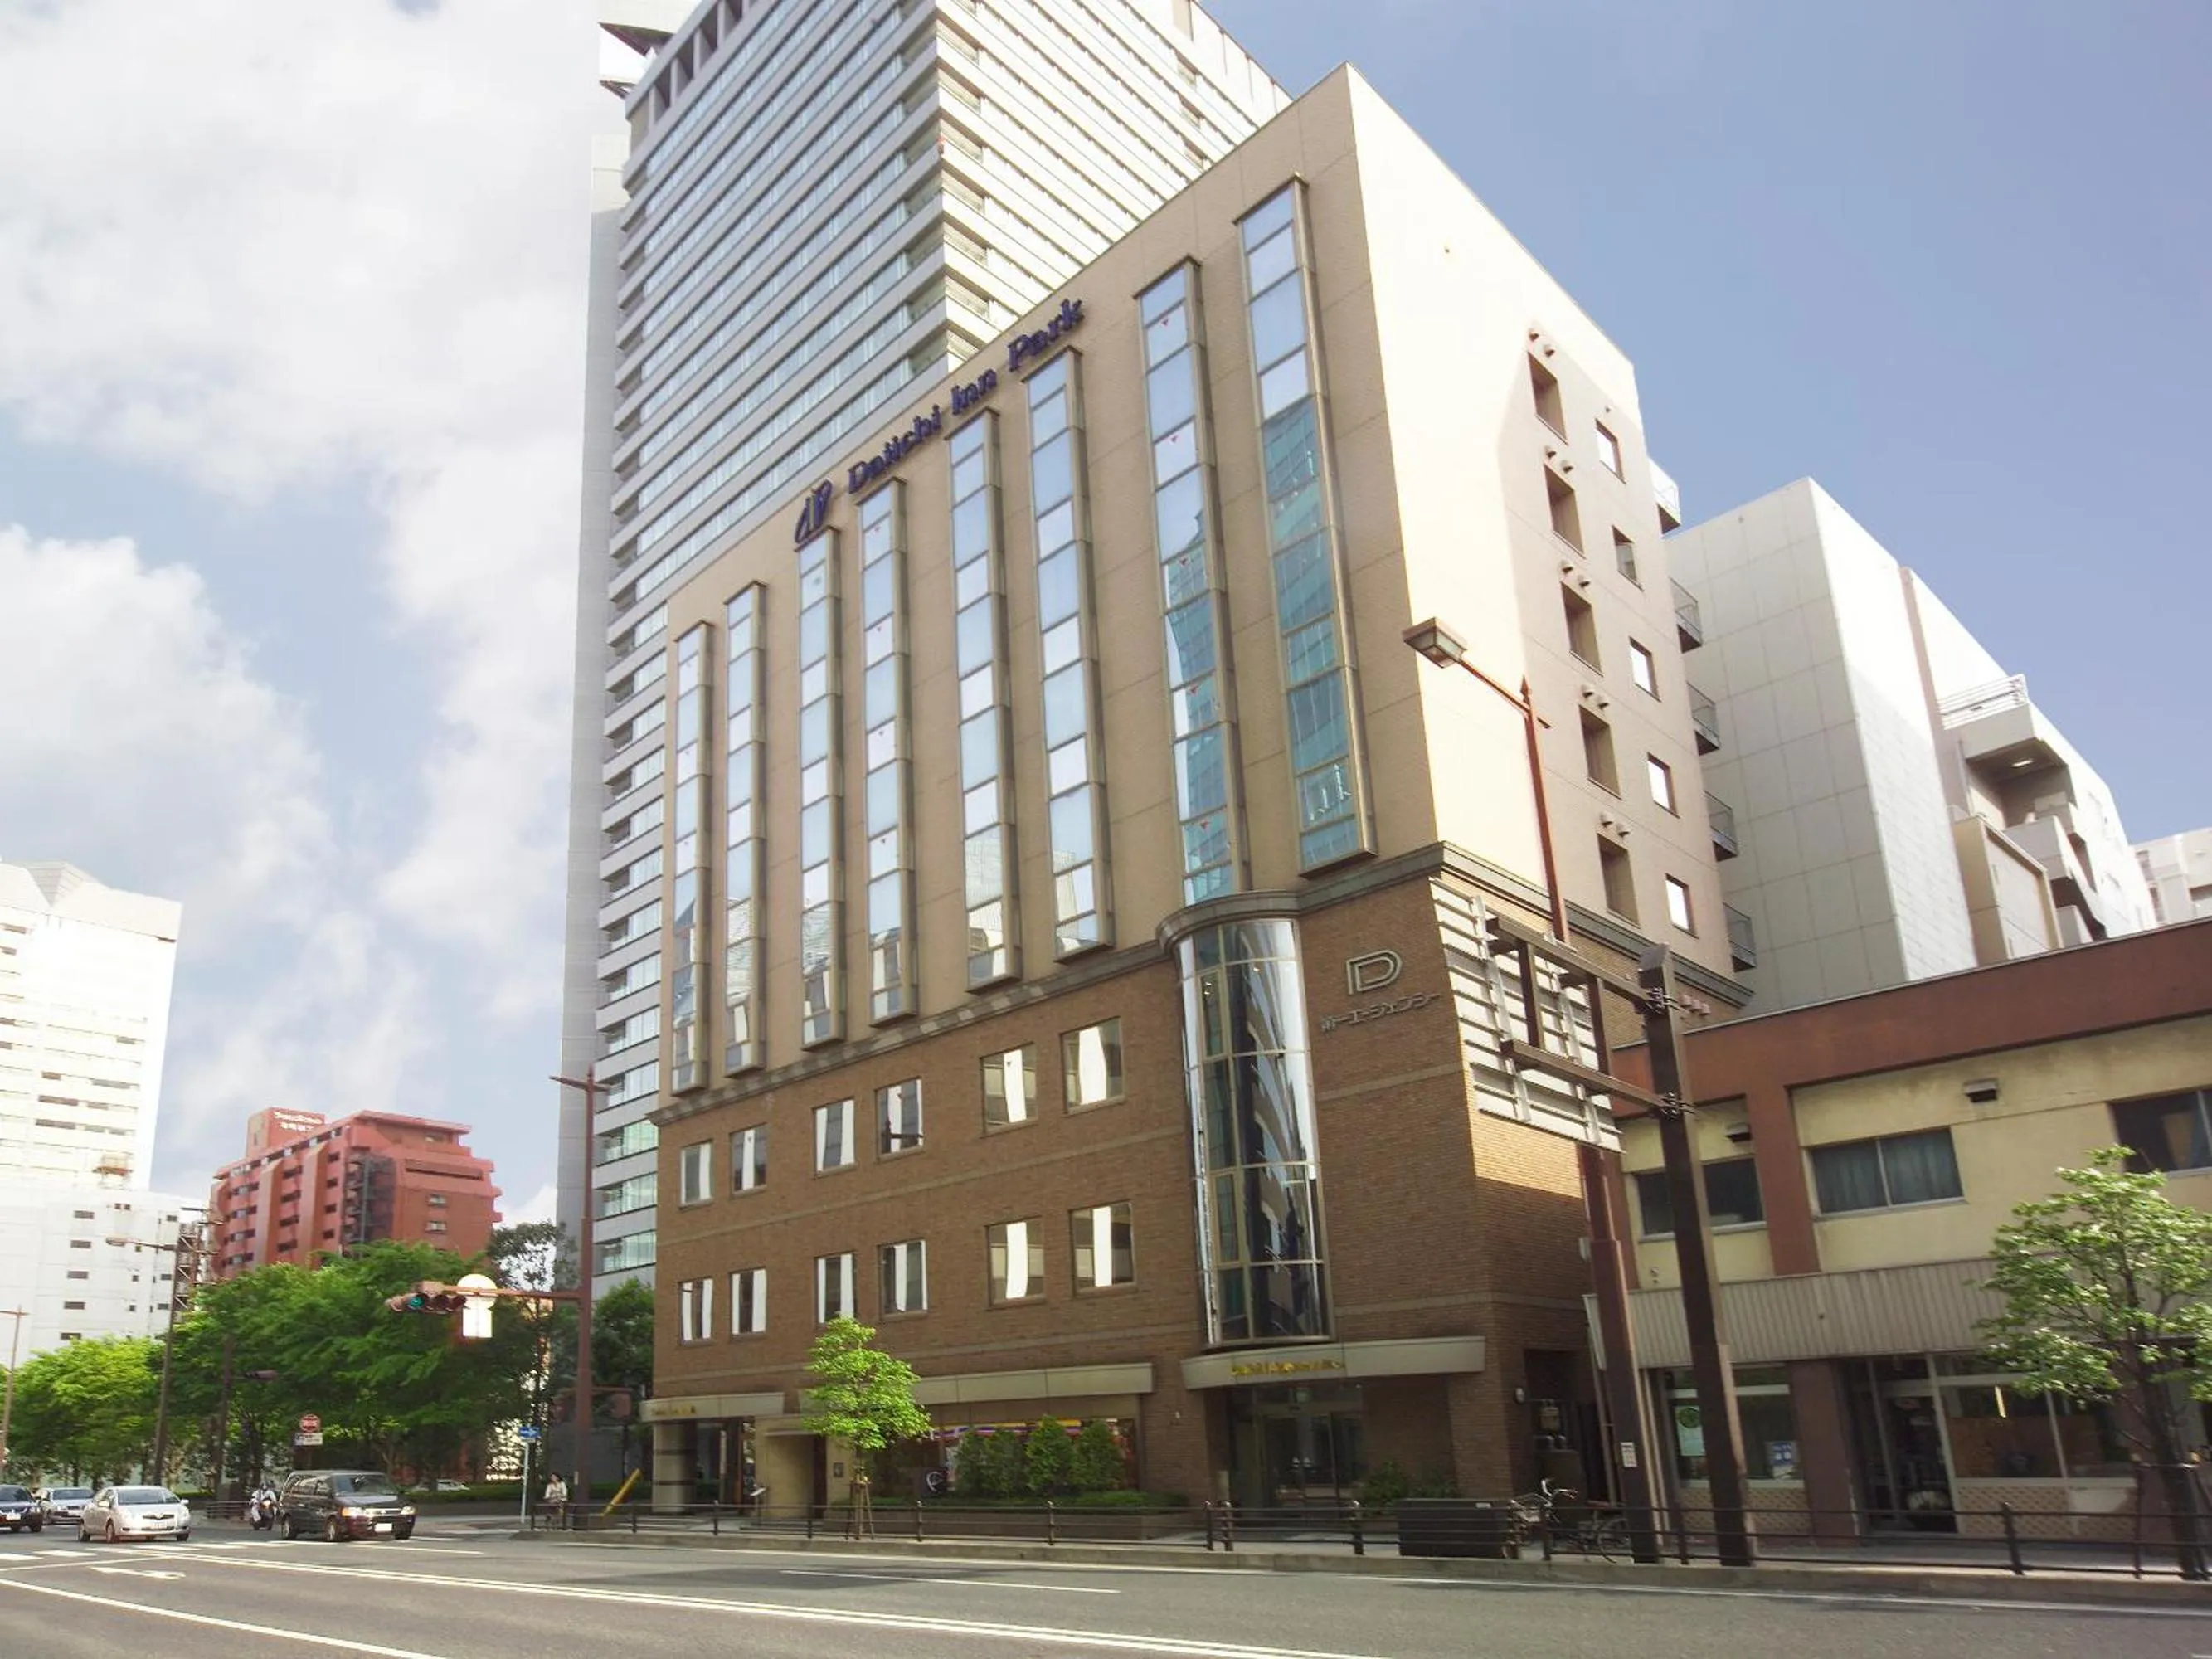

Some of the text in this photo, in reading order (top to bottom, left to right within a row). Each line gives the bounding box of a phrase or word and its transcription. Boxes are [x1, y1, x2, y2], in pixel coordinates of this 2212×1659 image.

[848, 299, 1085, 494] Daiichi Inn Park
